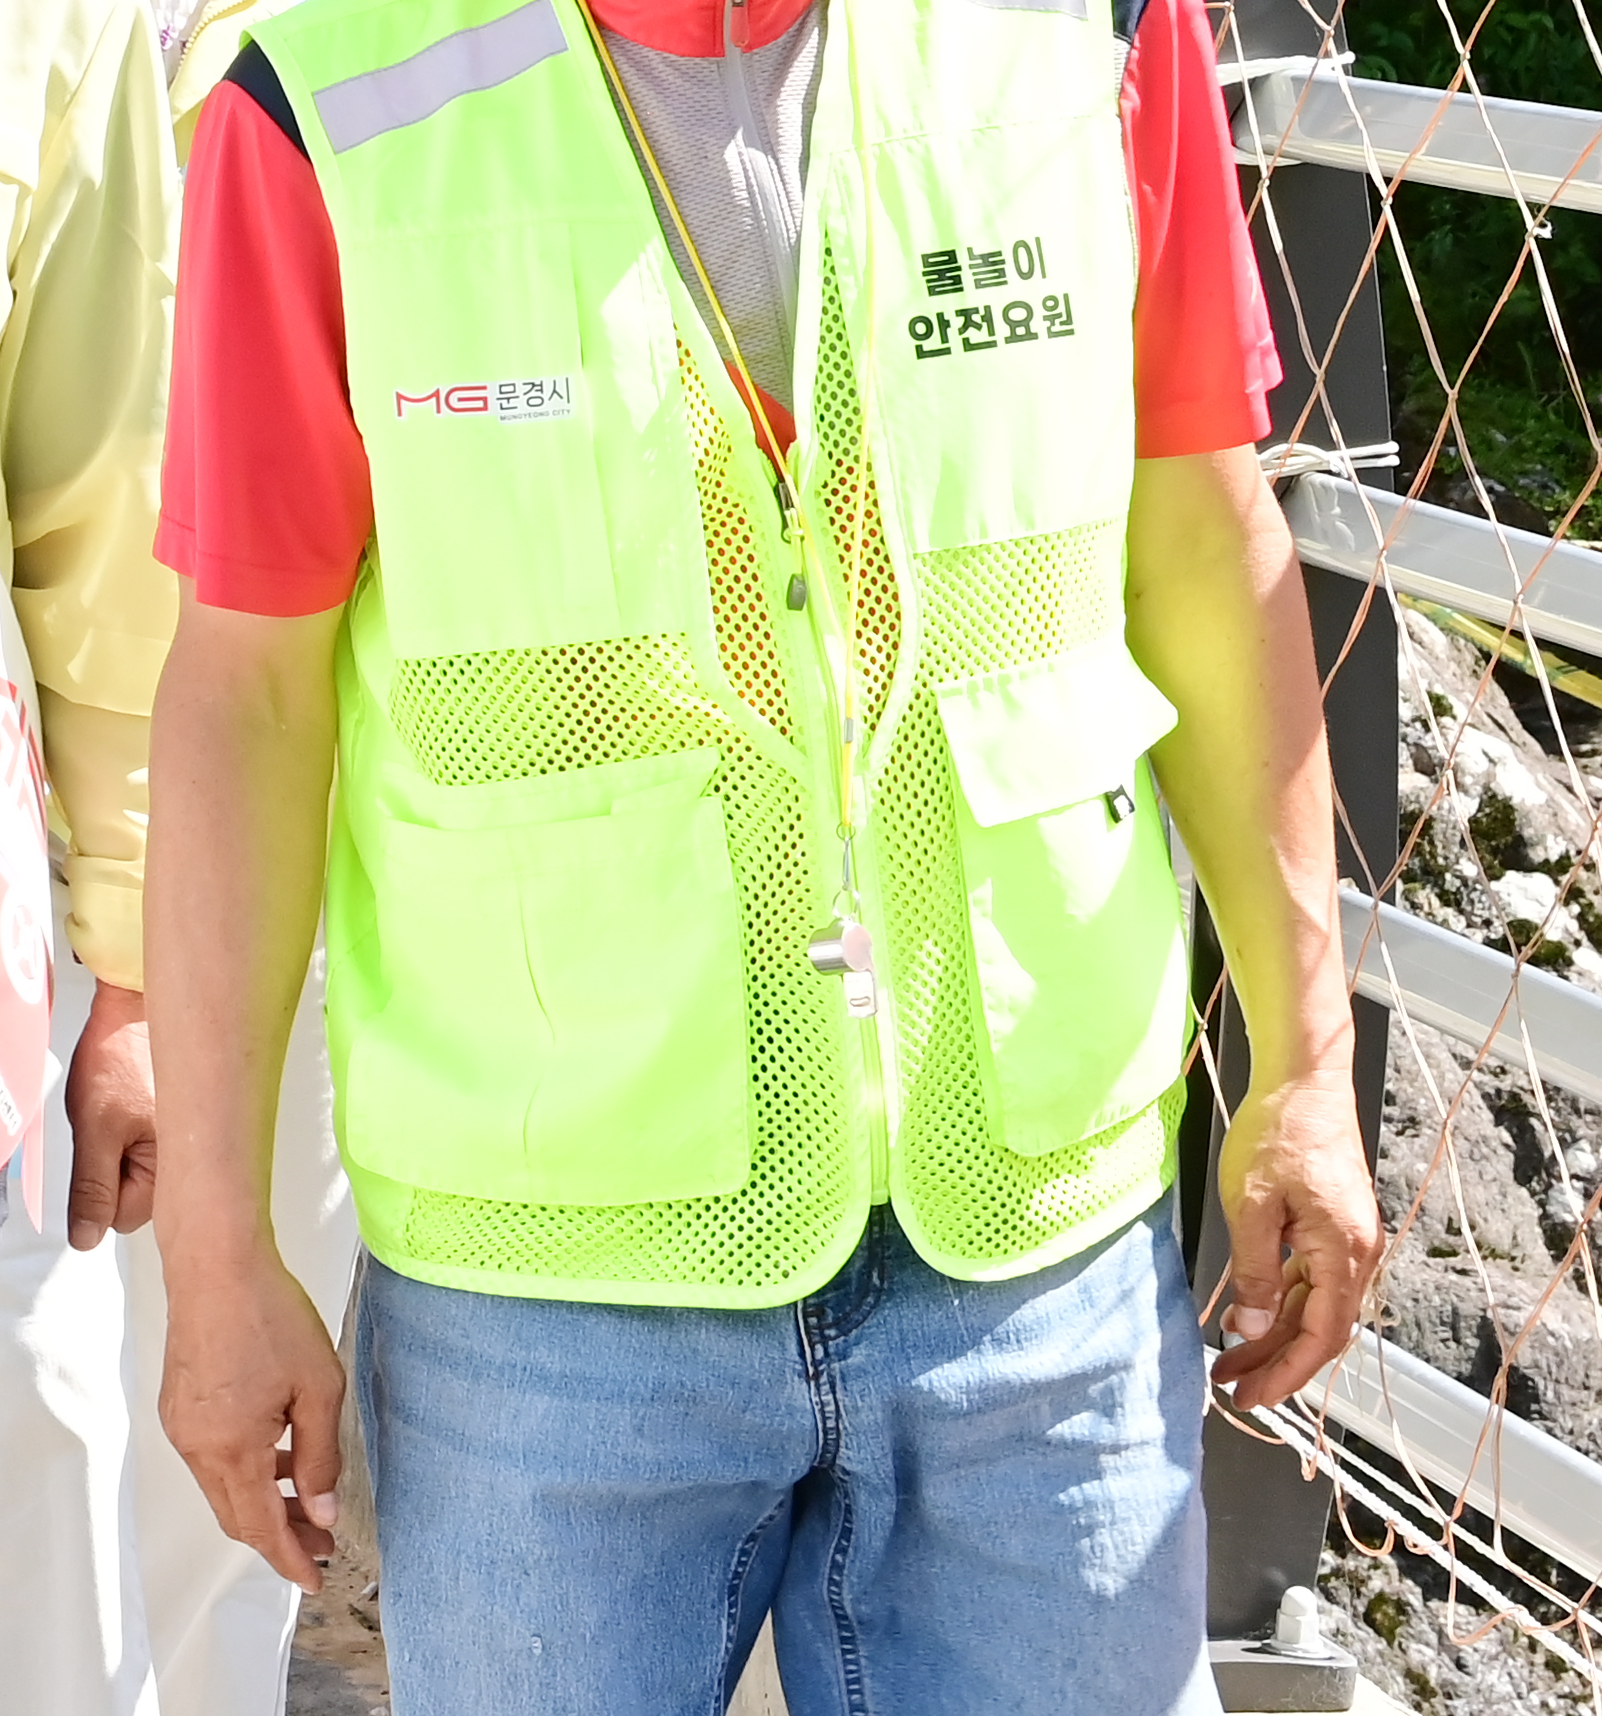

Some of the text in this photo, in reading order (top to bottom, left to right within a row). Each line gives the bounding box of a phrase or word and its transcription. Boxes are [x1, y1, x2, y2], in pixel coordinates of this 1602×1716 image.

[920, 235, 1049, 297] 물놀이
[908, 293, 1076, 360] 안전요원
[395, 377, 571, 417] MG 문경시
